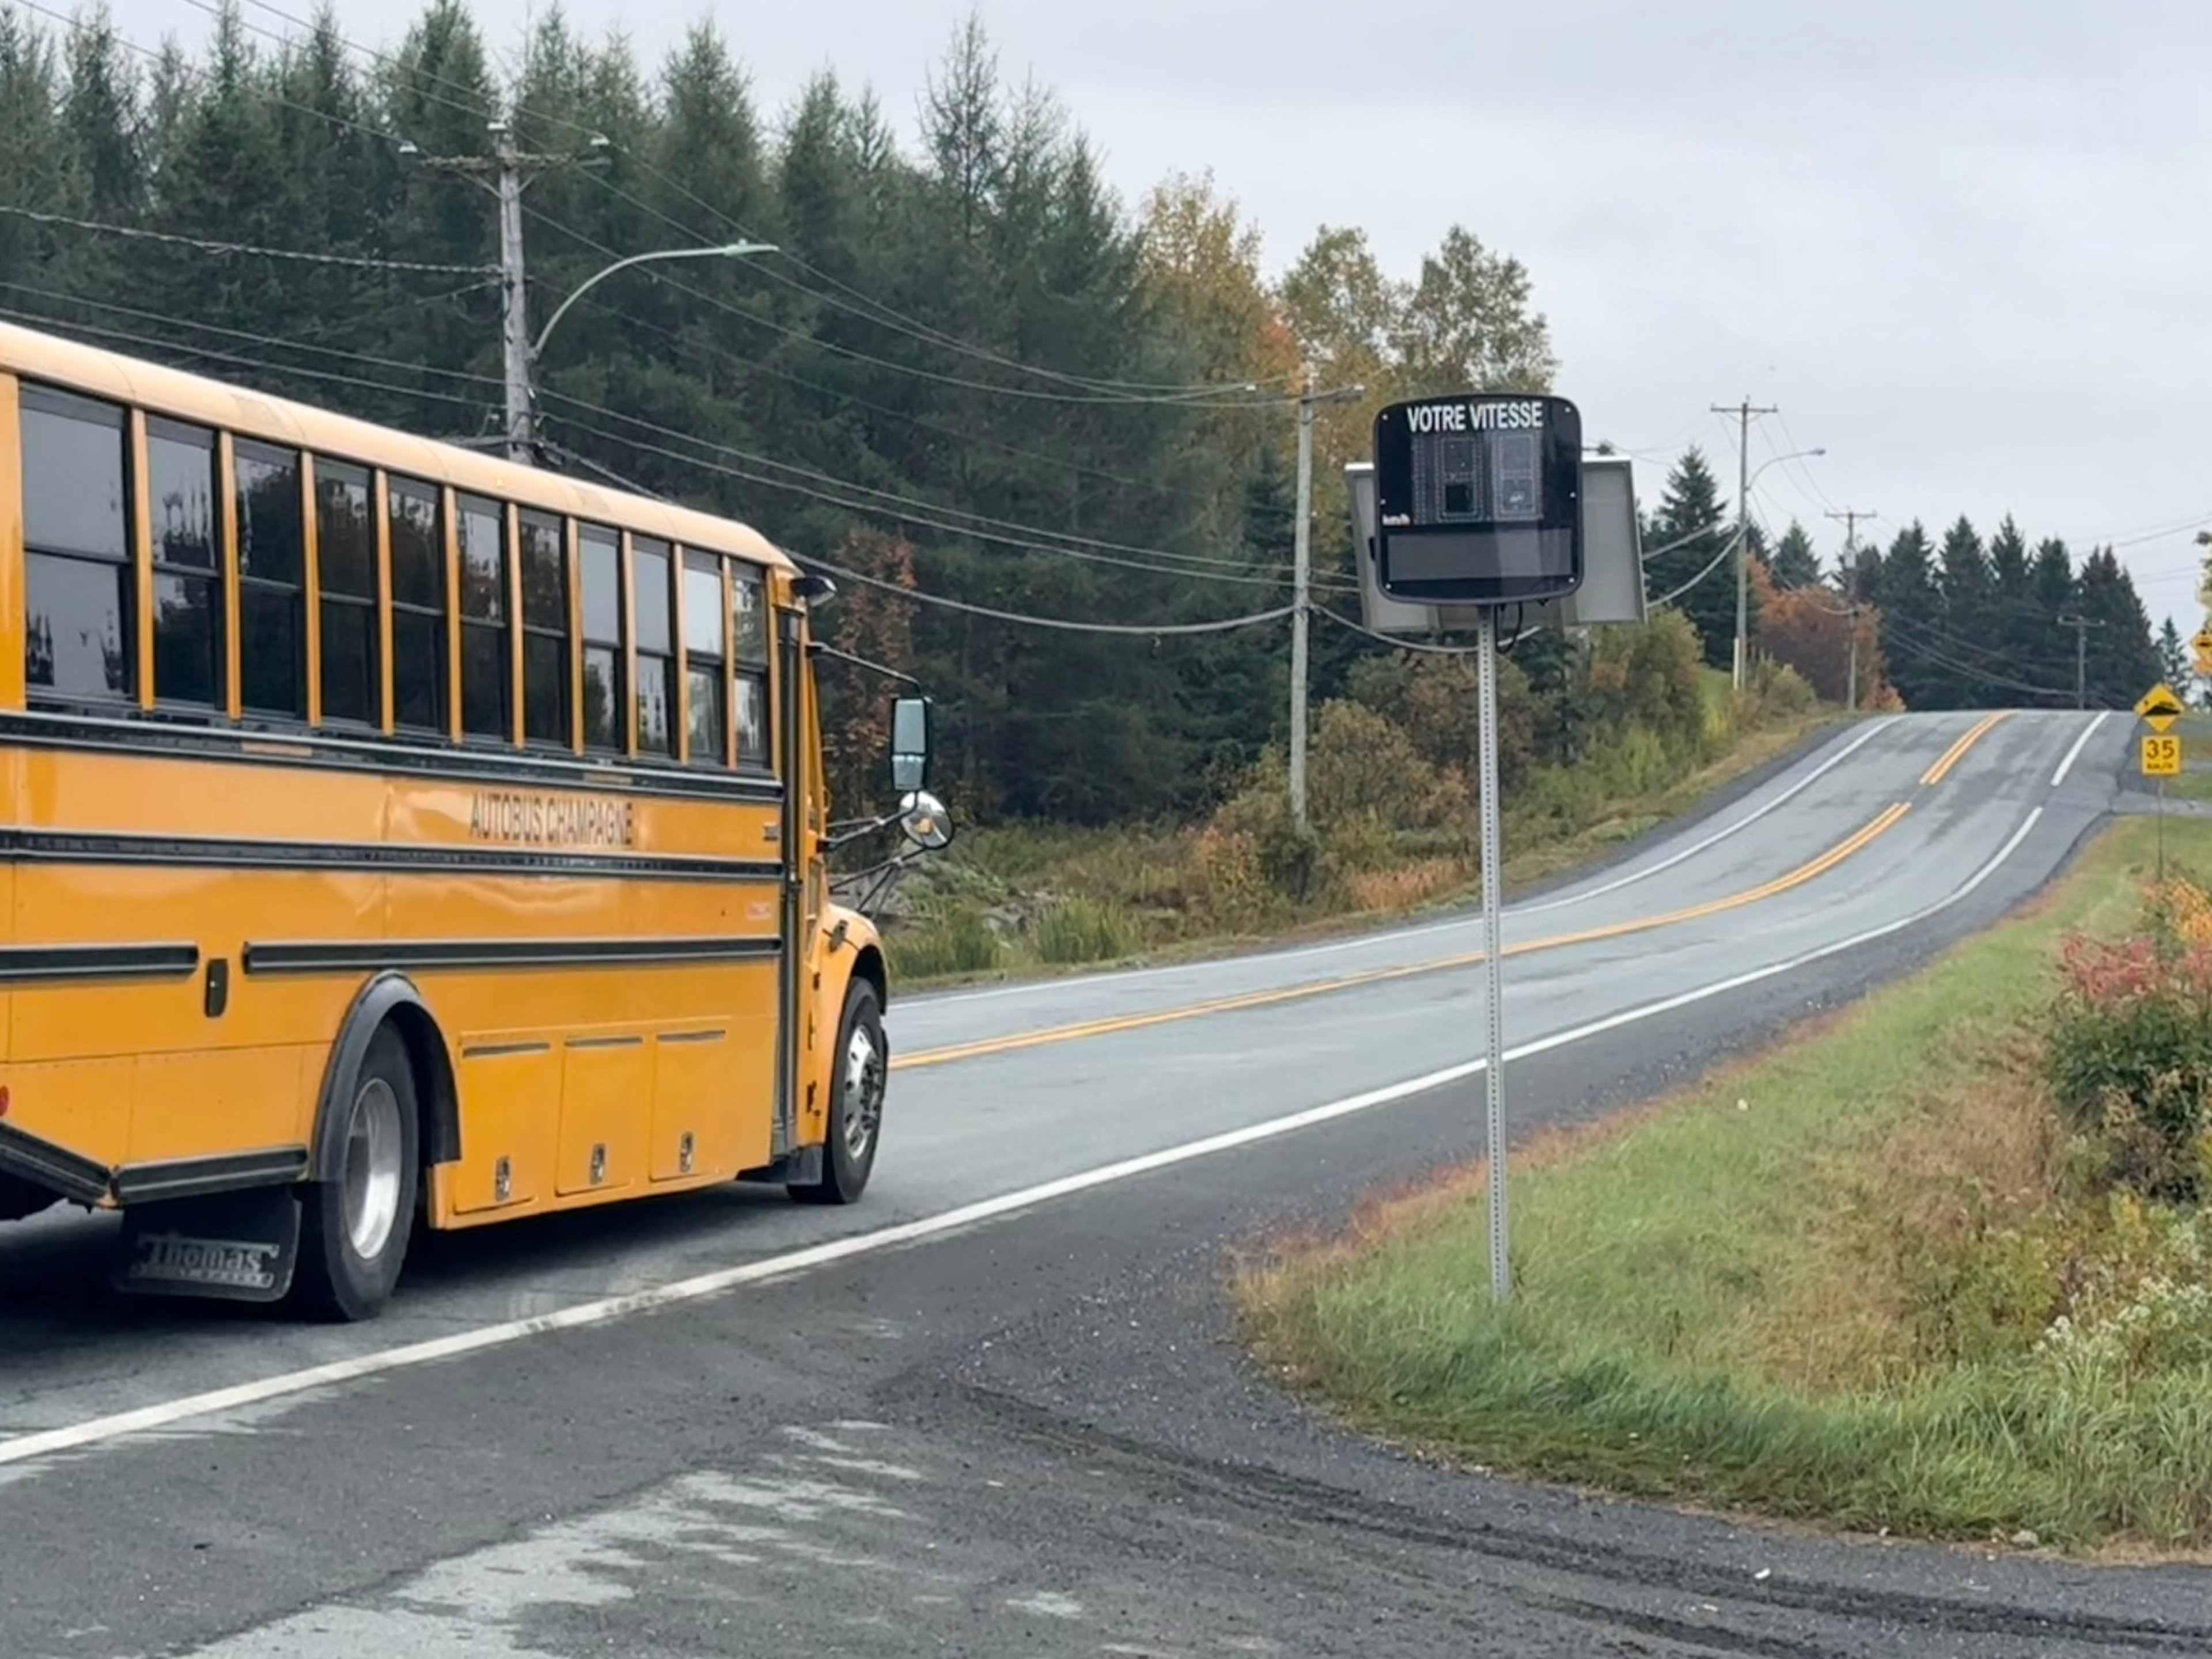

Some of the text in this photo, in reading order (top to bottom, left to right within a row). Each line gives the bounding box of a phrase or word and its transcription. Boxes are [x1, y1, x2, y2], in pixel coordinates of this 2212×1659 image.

[1407, 401, 1543, 432] VOTRE VITESSE
[2146, 740, 2175, 759] 35
[468, 791, 632, 846] AUTOBUS CHAMPAGNE
[139, 1235, 270, 1272] Thomas
